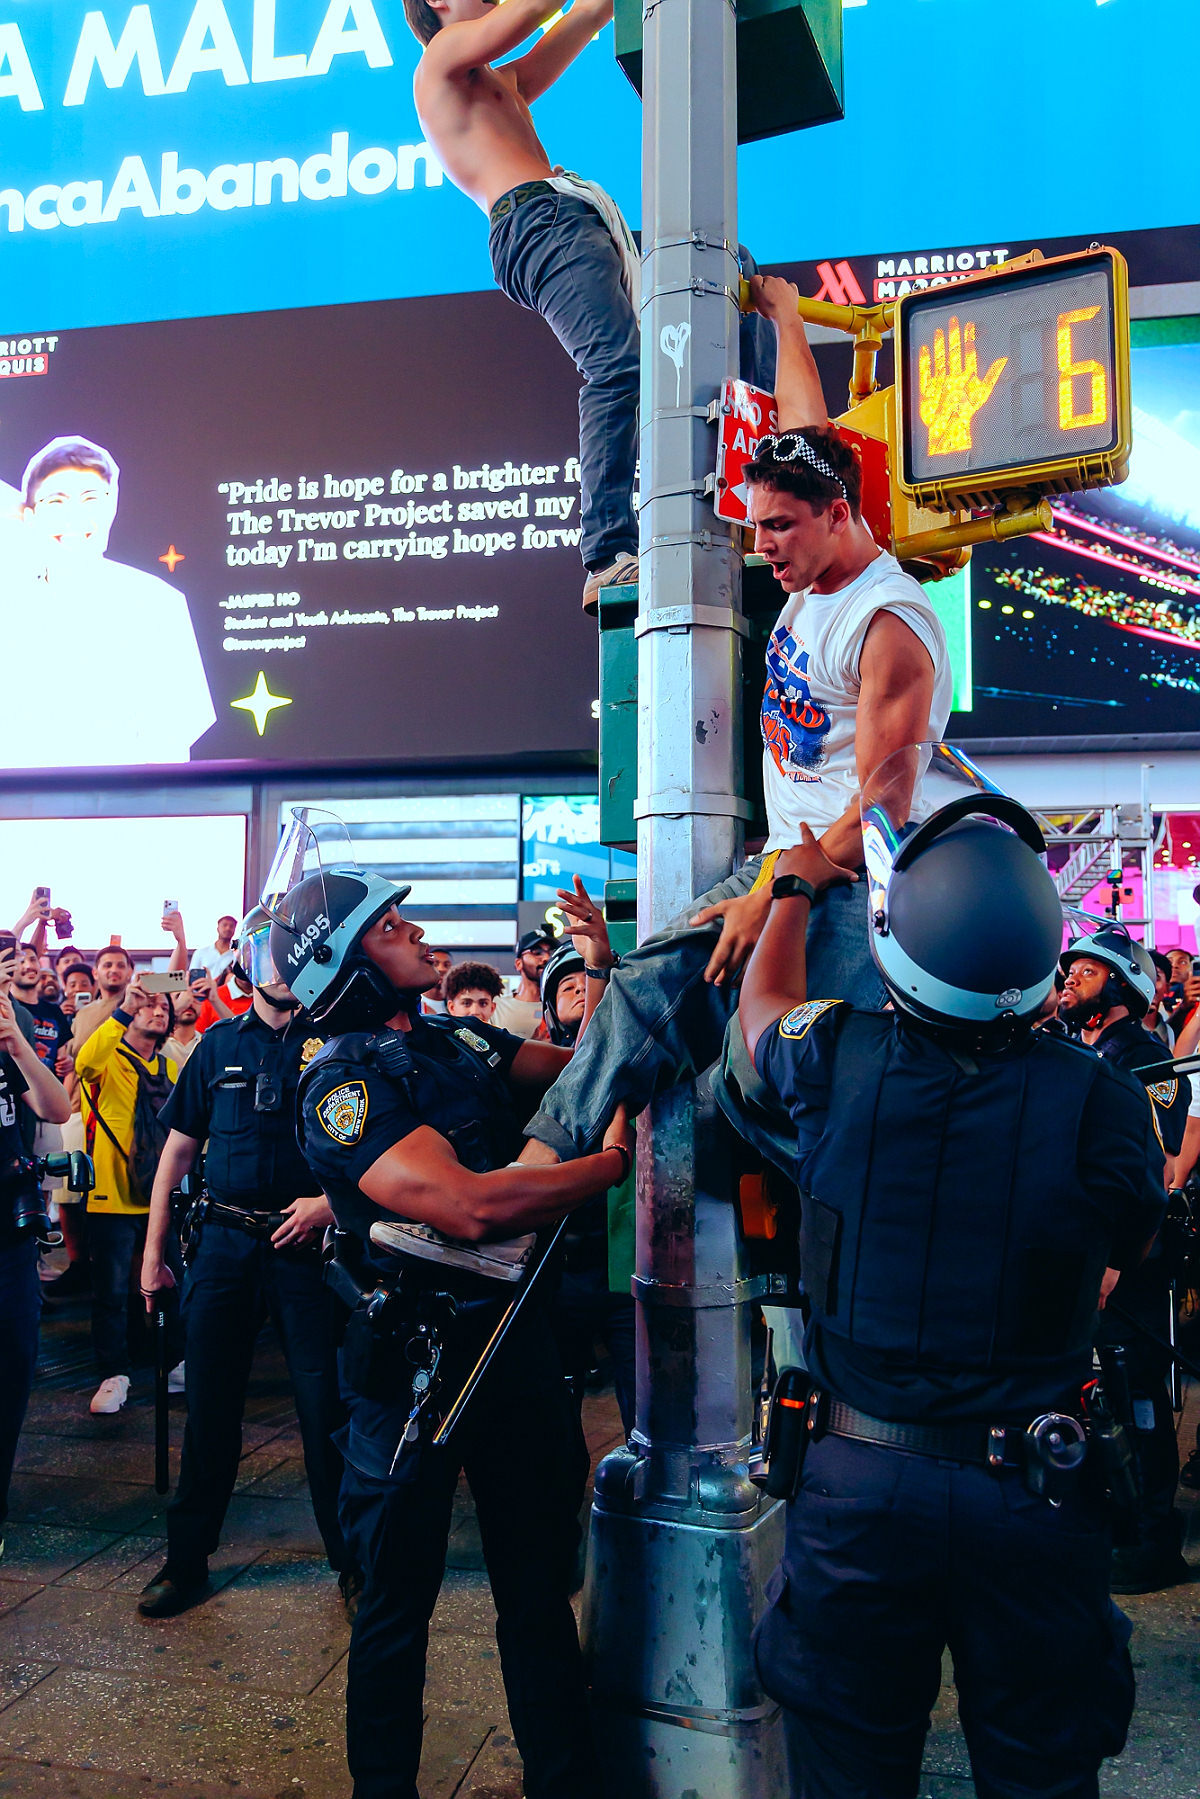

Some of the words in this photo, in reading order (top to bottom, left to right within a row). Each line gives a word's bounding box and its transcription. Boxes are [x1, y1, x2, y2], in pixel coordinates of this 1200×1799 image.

[62, 0, 394, 107] MALA
[877, 249, 1009, 278] MARRIOTT
[1056, 305, 1107, 431] 6
[297, 475, 319, 500] is
[323, 473, 385, 501] hope
[390, 469, 428, 494] for
[432, 472, 448, 491] a
[452, 461, 559, 492] brighter
[226, 510, 273, 535] The
[277, 508, 360, 532] Trevor
[364, 500, 453, 529] Project
[457, 492, 529, 522] saved
[534, 496, 576, 520] my
[226, 539, 293, 568] today
[343, 531, 449, 562] carrying
[452, 528, 516, 557] hope
[287, 913, 330, 967] 14495
[322, 1090, 361, 1118] DEPARTMENT
[327, 1087, 350, 1105] POLICE
[327, 1124, 339, 1136] CITY
